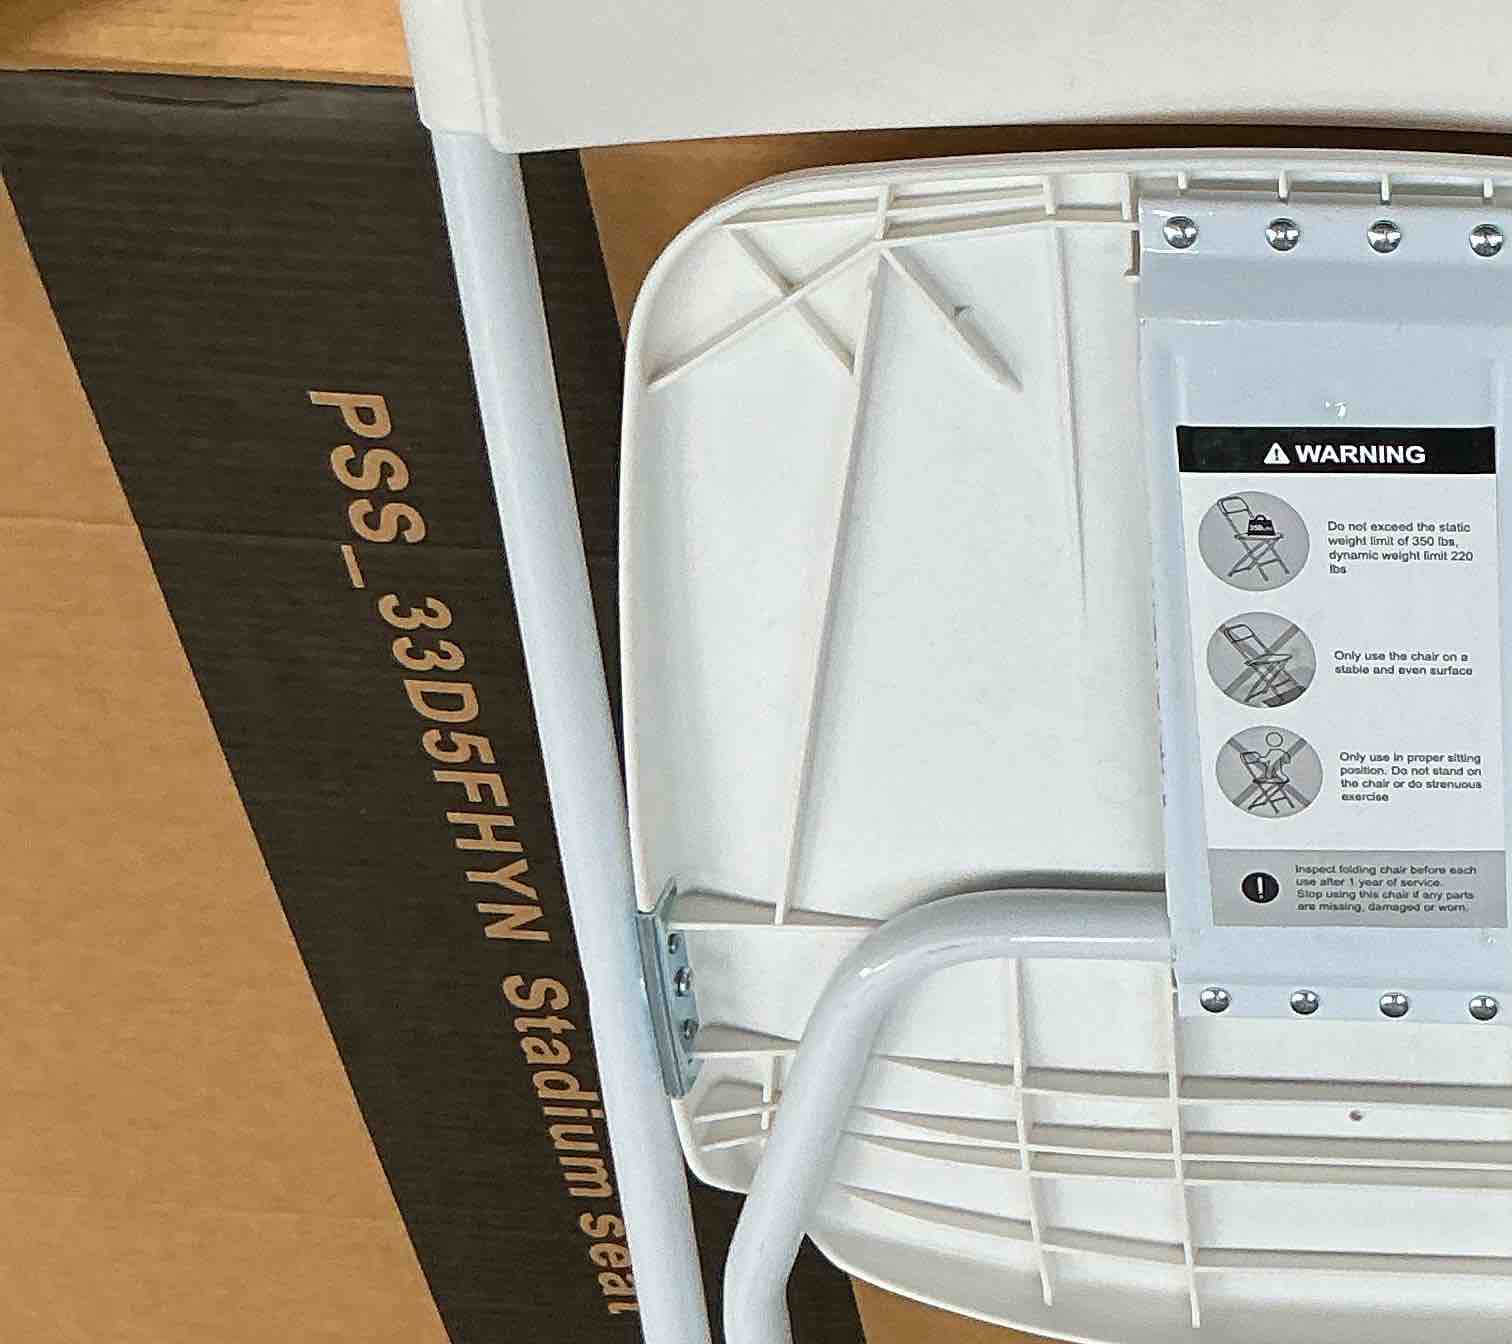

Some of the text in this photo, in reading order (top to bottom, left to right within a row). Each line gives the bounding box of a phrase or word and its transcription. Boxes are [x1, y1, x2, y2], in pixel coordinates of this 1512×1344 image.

[1294, 444, 1426, 465] WARNING
[1328, 521, 1471, 532] Do not exceed the static
[1328, 536, 1367, 547] weight
[1370, 536, 1394, 546] limit
[1397, 536, 1409, 546] of
[1412, 537, 1434, 546] 350
[1329, 550, 1473, 562] dynamic weight limit 220
[1330, 564, 1346, 574] lbs
[1334, 650, 1361, 662] Only
[1389, 652, 1407, 660] the
[1411, 651, 1439, 661] chair
[1335, 665, 1472, 675] stable and even surface
[1340, 751, 1481, 764] Only use in proper sitting
[1391, 766, 1408, 775] Do
[1411, 766, 1429, 775] not
[1433, 766, 1463, 776] stand
[1467, 768, 1481, 776] on
[1341, 779, 1358, 788] the
[1362, 779, 1389, 788] chair
[1408, 780, 1422, 788] do
[1426, 780, 1482, 789] strenuous
[306, 388, 551, 943] PSS_33D5FHYN
[500, 974, 614, 1198] Stadium
[1342, 792, 1389, 801] exercise
